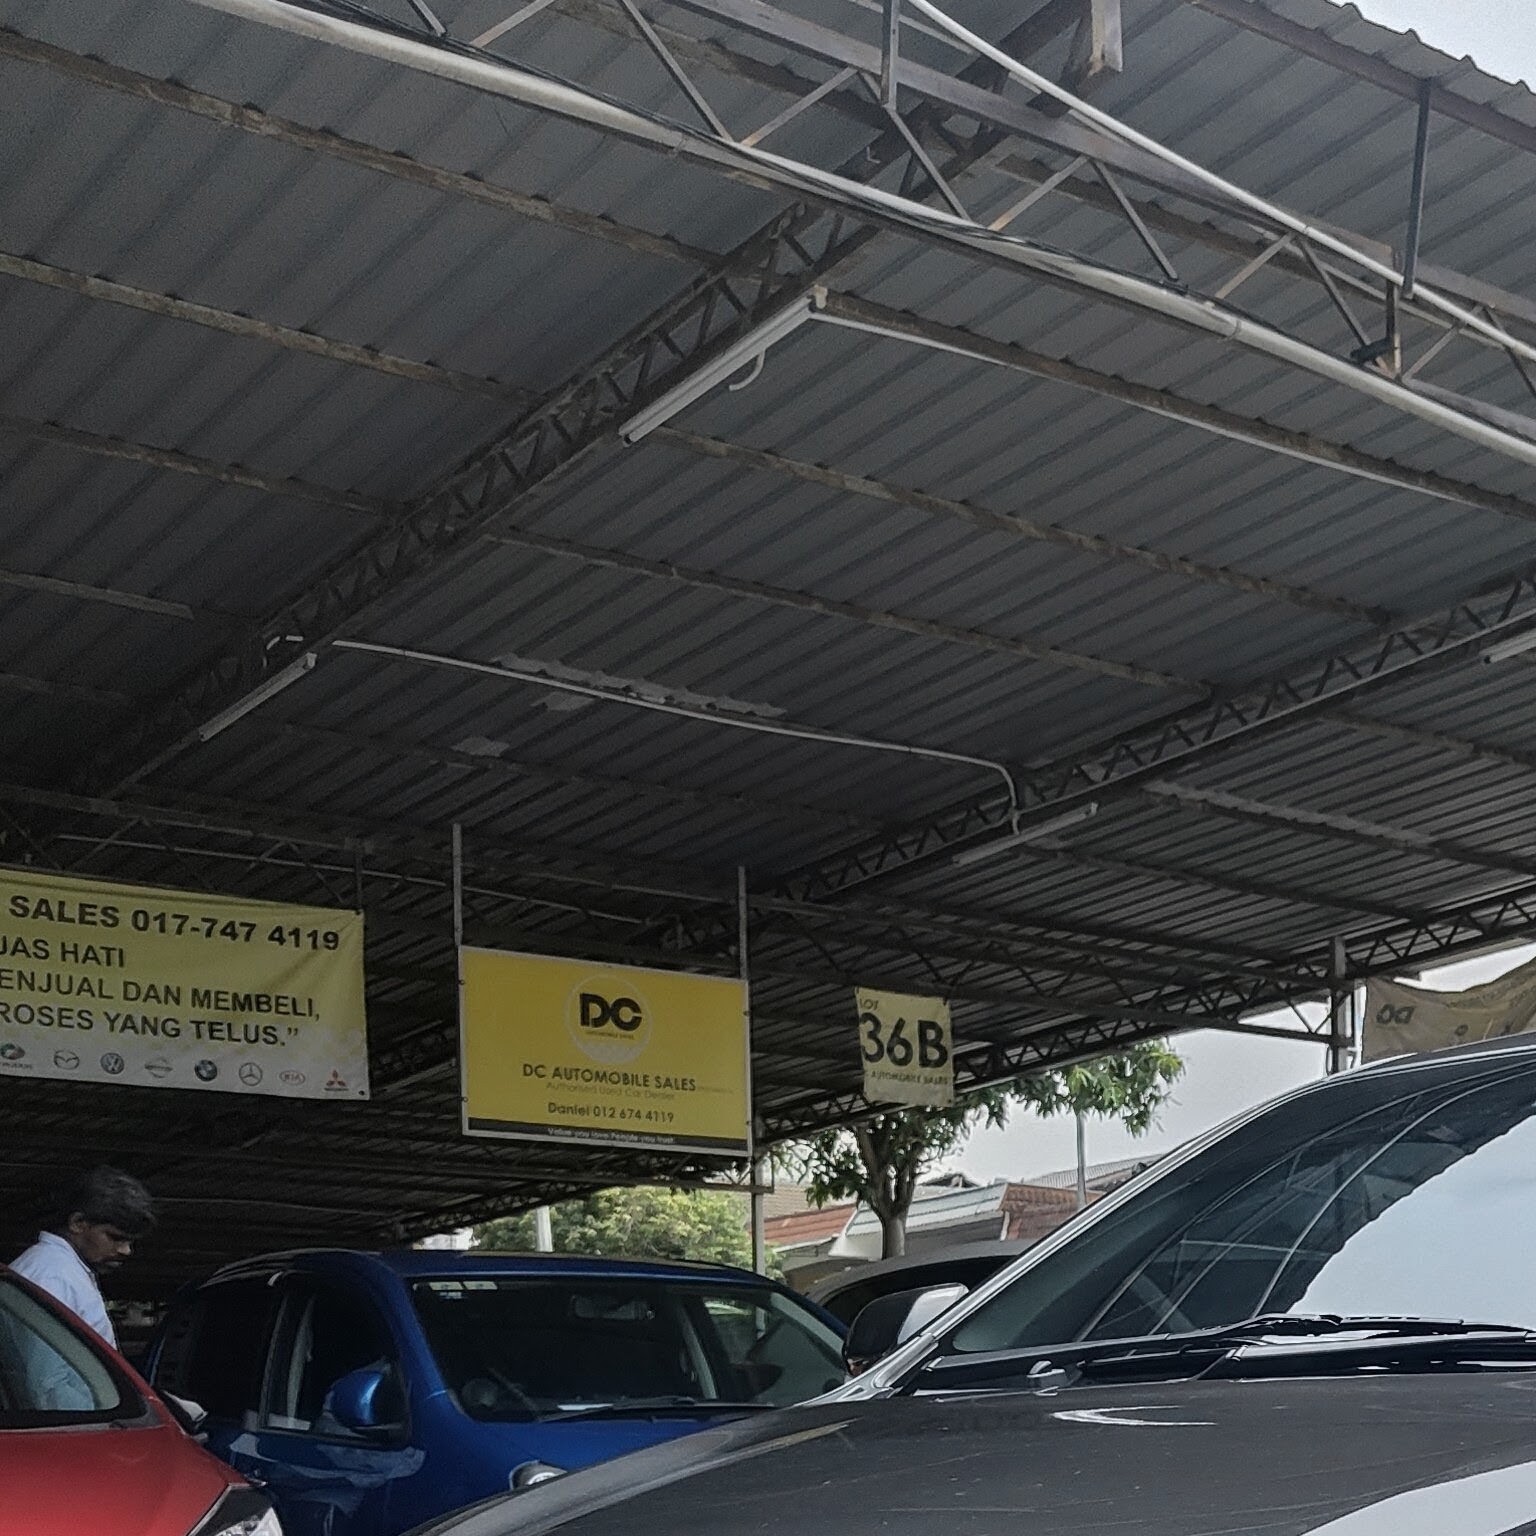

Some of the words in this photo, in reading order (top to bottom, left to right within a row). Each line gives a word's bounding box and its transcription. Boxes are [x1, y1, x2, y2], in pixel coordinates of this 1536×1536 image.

[9, 895, 120, 928] SALES
[131, 909, 257, 943] 017-747
[268, 926, 340, 950] 4119
[61, 942, 124, 968] HATI
[122, 980, 181, 1006] DAN
[191, 987, 321, 1021] MEMBELI,
[579, 992, 642, 1031] DC
[103, 1012, 181, 1039] YANG
[860, 1012, 948, 1068] 36B
[522, 1063, 546, 1079] DC
[552, 1066, 650, 1088] AUTOMOBILE
[655, 1075, 696, 1092] SALES
[548, 1102, 590, 1117] Daniel
[593, 1106, 618, 1119] 012
[620, 1108, 642, 1120] 674
[645, 1110, 674, 1123] 4119
